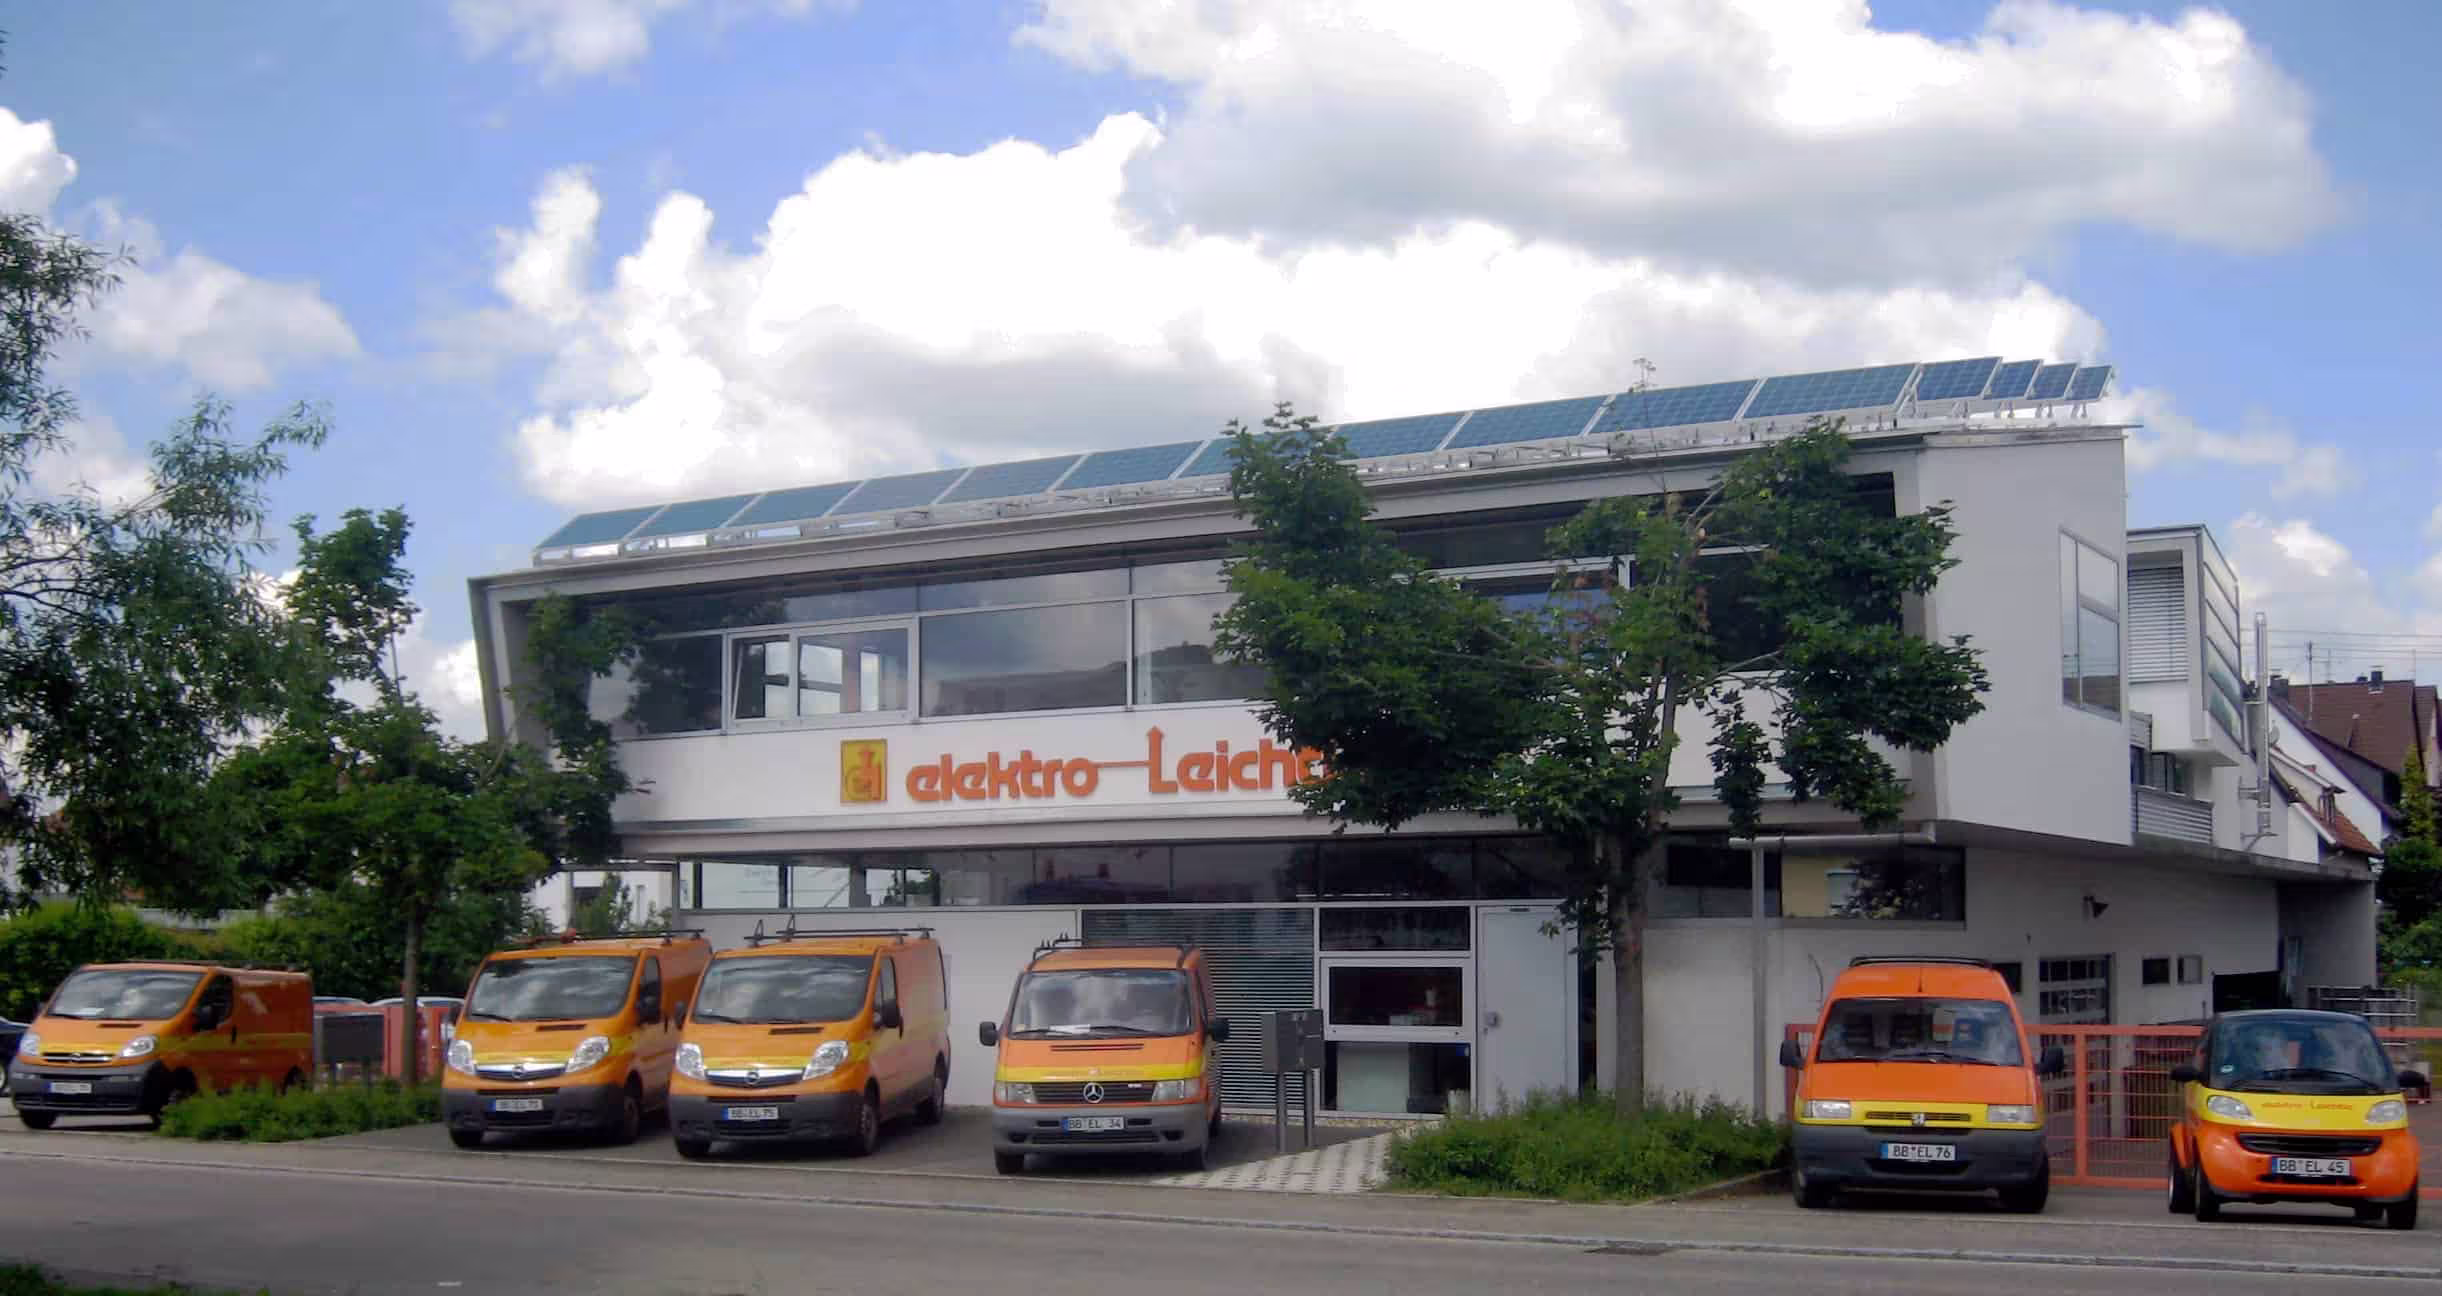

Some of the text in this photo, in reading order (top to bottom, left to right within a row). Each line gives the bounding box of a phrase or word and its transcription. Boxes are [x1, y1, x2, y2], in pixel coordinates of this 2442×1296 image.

[906, 750, 1099, 802] elektro
[1069, 1119, 1082, 1129] BB
[1088, 1119, 1102, 1129] EL
[1893, 1144, 1951, 1159] BB EL 76
[2279, 1159, 2345, 1174] BB EL 45
